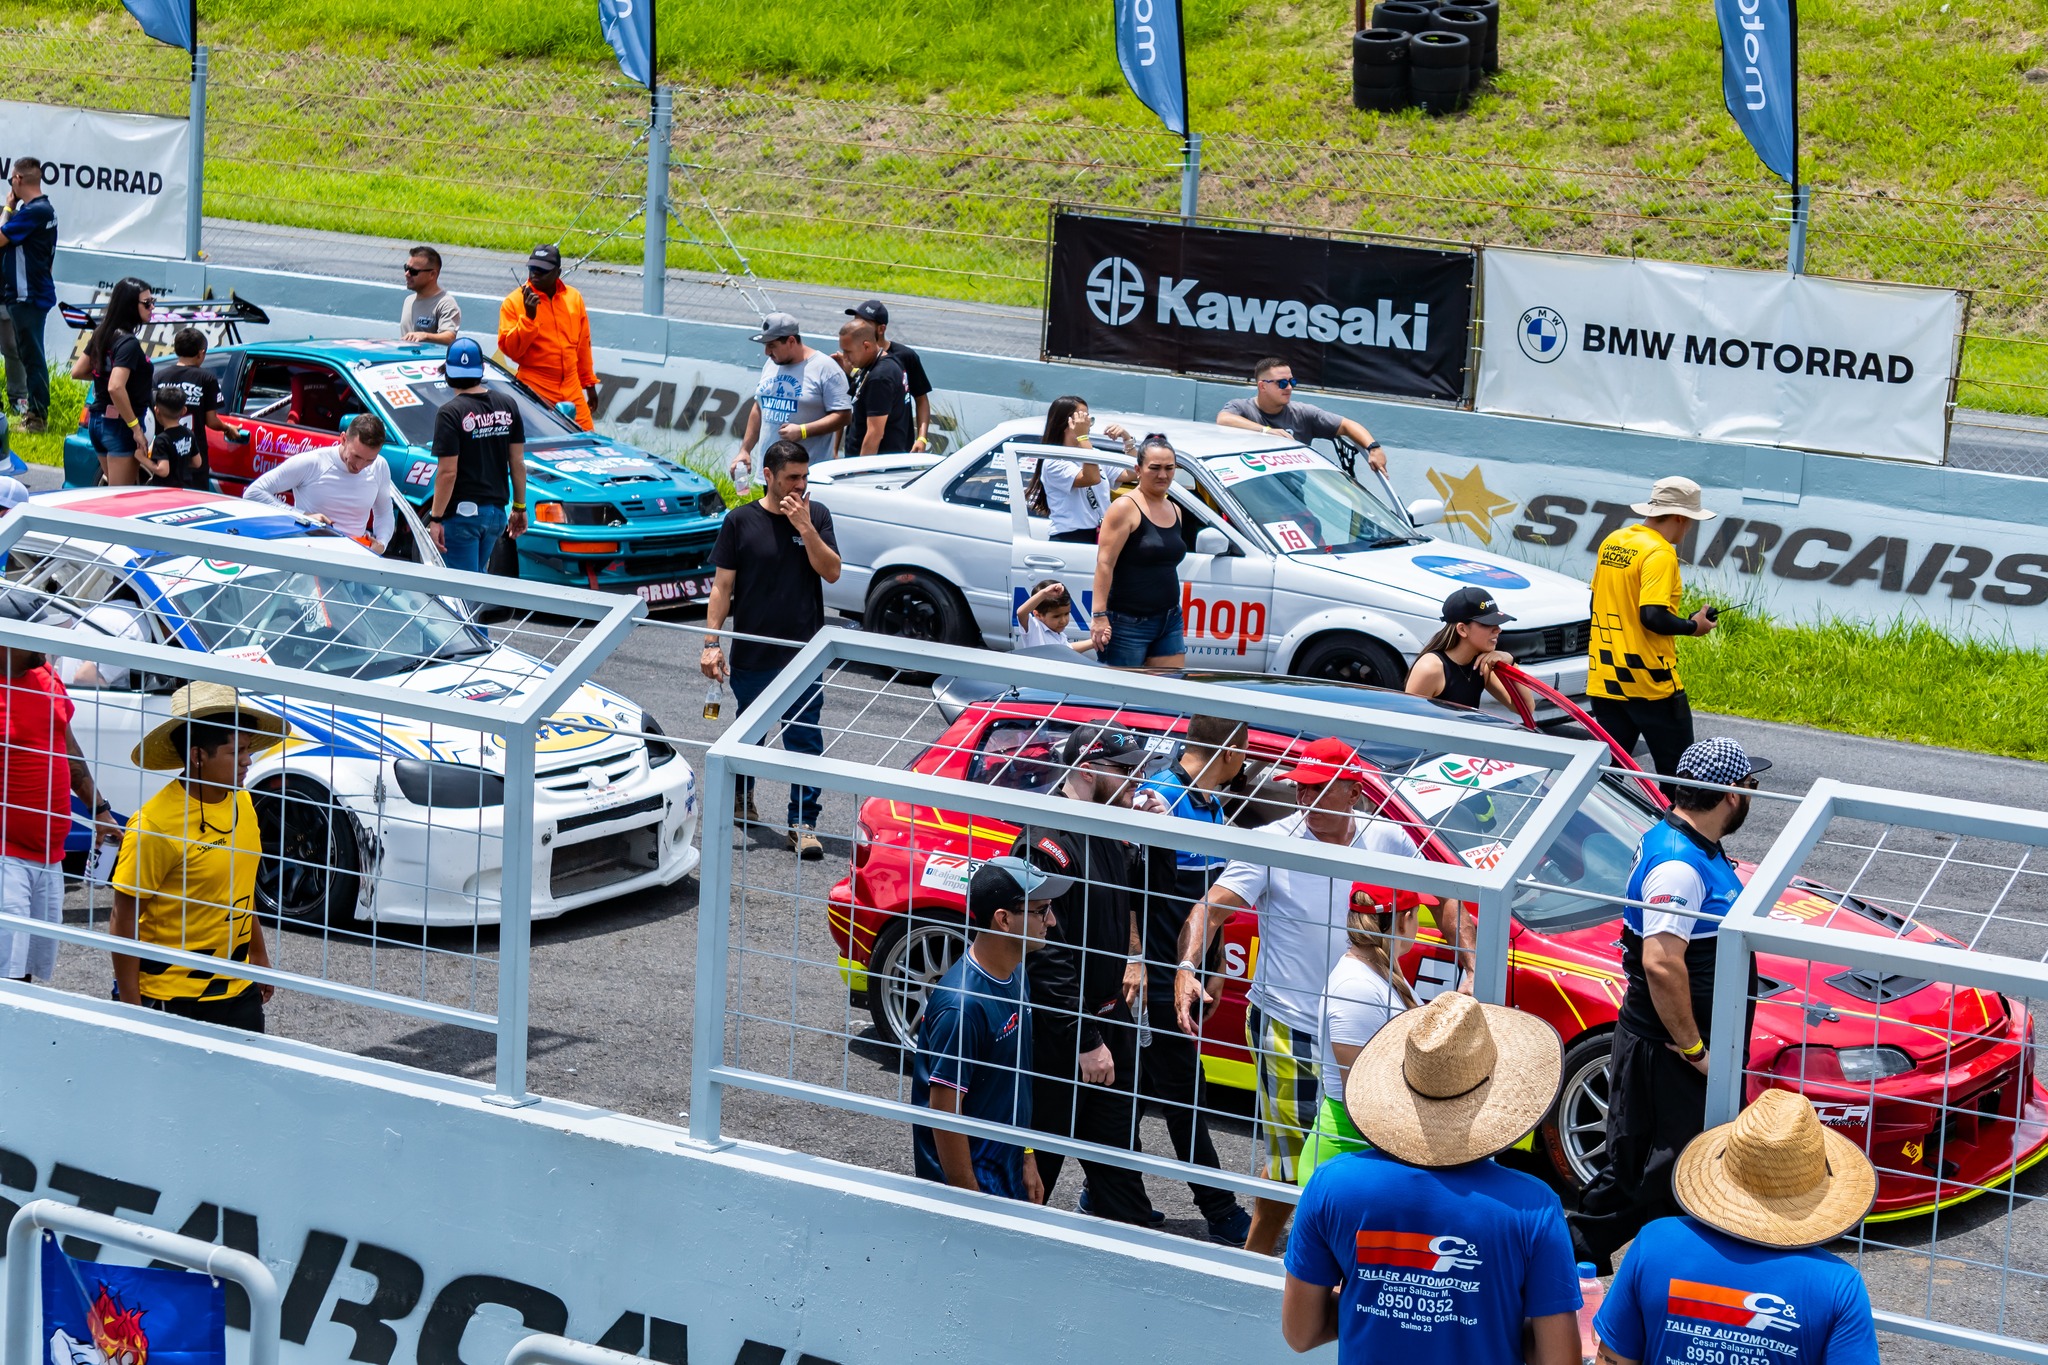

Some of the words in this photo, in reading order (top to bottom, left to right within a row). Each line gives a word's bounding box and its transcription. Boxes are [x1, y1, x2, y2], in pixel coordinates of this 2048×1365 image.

[41, 161, 163, 195] OTORRAD
[1157, 275, 1429, 352] Kawasaki
[1523, 309, 1562, 326] BMW
[1583, 323, 1675, 360] BMW
[1684, 335, 1914, 385] MOTORRAD
[386, 389, 416, 406] 22
[762, 396, 797, 411] NATIONAL
[1261, 452, 1314, 467] Castrol
[406, 461, 438, 486] 22
[1280, 530, 1307, 550] 19
[1512, 493, 2048, 607] STRCARS
[1465, 850, 1481, 858] GT3
[1358, 1269, 1400, 1281] TALLER
[1403, 1273, 1480, 1291] AUTOMOTRIZ
[1382, 1283, 1407, 1293] Cesar
[1409, 1286, 1439, 1298] Salazar
[1441, 1289, 1451, 1297] M.
[1377, 1292, 1413, 1309] 8950
[1417, 1298, 1454, 1313] 0352
[1356, 1303, 1390, 1319] Puriscal,
[1392, 1309, 1409, 1320] San
[1411, 1312, 1432, 1323] Jose
[1434, 1313, 1459, 1323] Costa
[1460, 1315, 1478, 1325] Rica
[1401, 1321, 1422, 1331] Salmo
[1666, 1320, 1711, 1336] TALLER
[1714, 1329, 1799, 1354] AUTOMOTRIZ
[1692, 1337, 1718, 1349] Cesar
[1720, 1341, 1755, 1355] Salazar
[1756, 1348, 1767, 1357] M.
[1686, 1346, 1725, 1365] 8950
